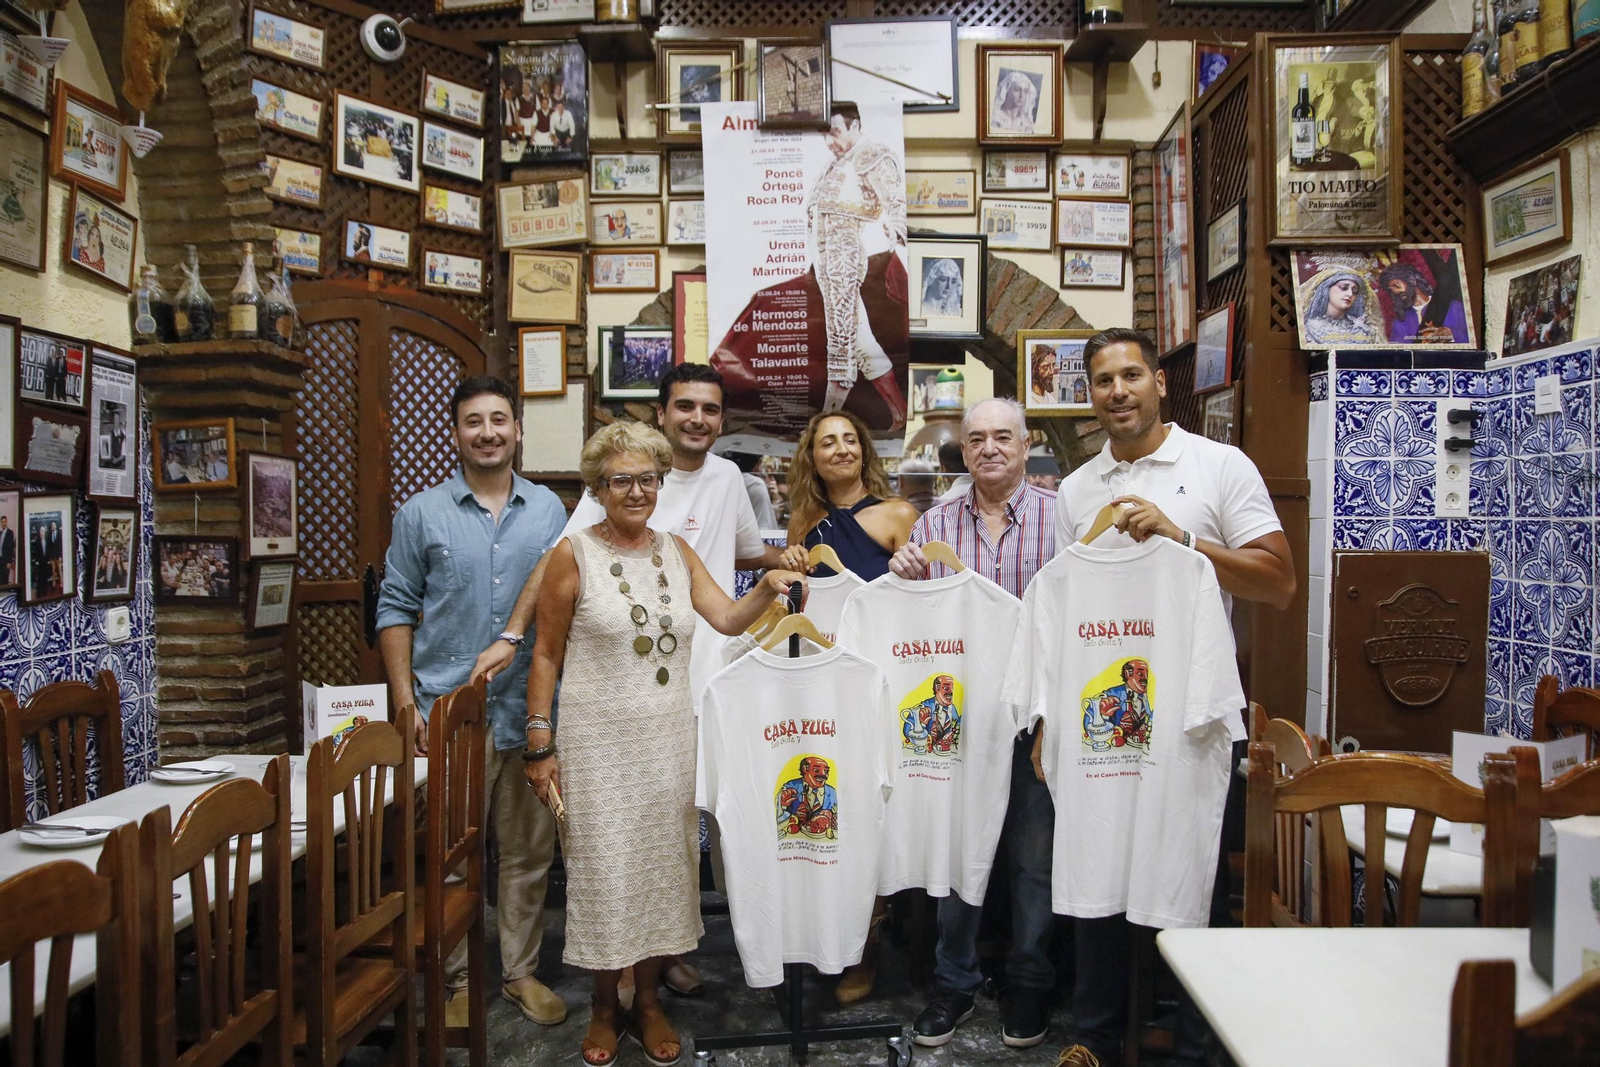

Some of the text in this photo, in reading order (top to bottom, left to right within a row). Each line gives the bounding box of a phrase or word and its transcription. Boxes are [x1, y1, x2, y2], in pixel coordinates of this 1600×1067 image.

[765, 170, 803, 178] Ponce
[762, 182, 804, 193] Ortega
[1289, 180, 1377, 194] TIO MATEO
[747, 194, 804, 206] Roca Rey
[769, 240, 805, 250] Ureña
[766, 253, 805, 264] Adrián
[533, 262, 572, 286] CASA PUGA
[752, 310, 808, 320] Hermoso
[733, 320, 808, 332] de Mendoza
[757, 342, 808, 354] Morante
[750, 356, 808, 368] Talavante
[1078, 620, 1120, 640] CASA
[892, 640, 932, 658] CASA
[331, 699, 374, 709] CASA PUGA
[764, 718, 836, 742] CASA PUGA
